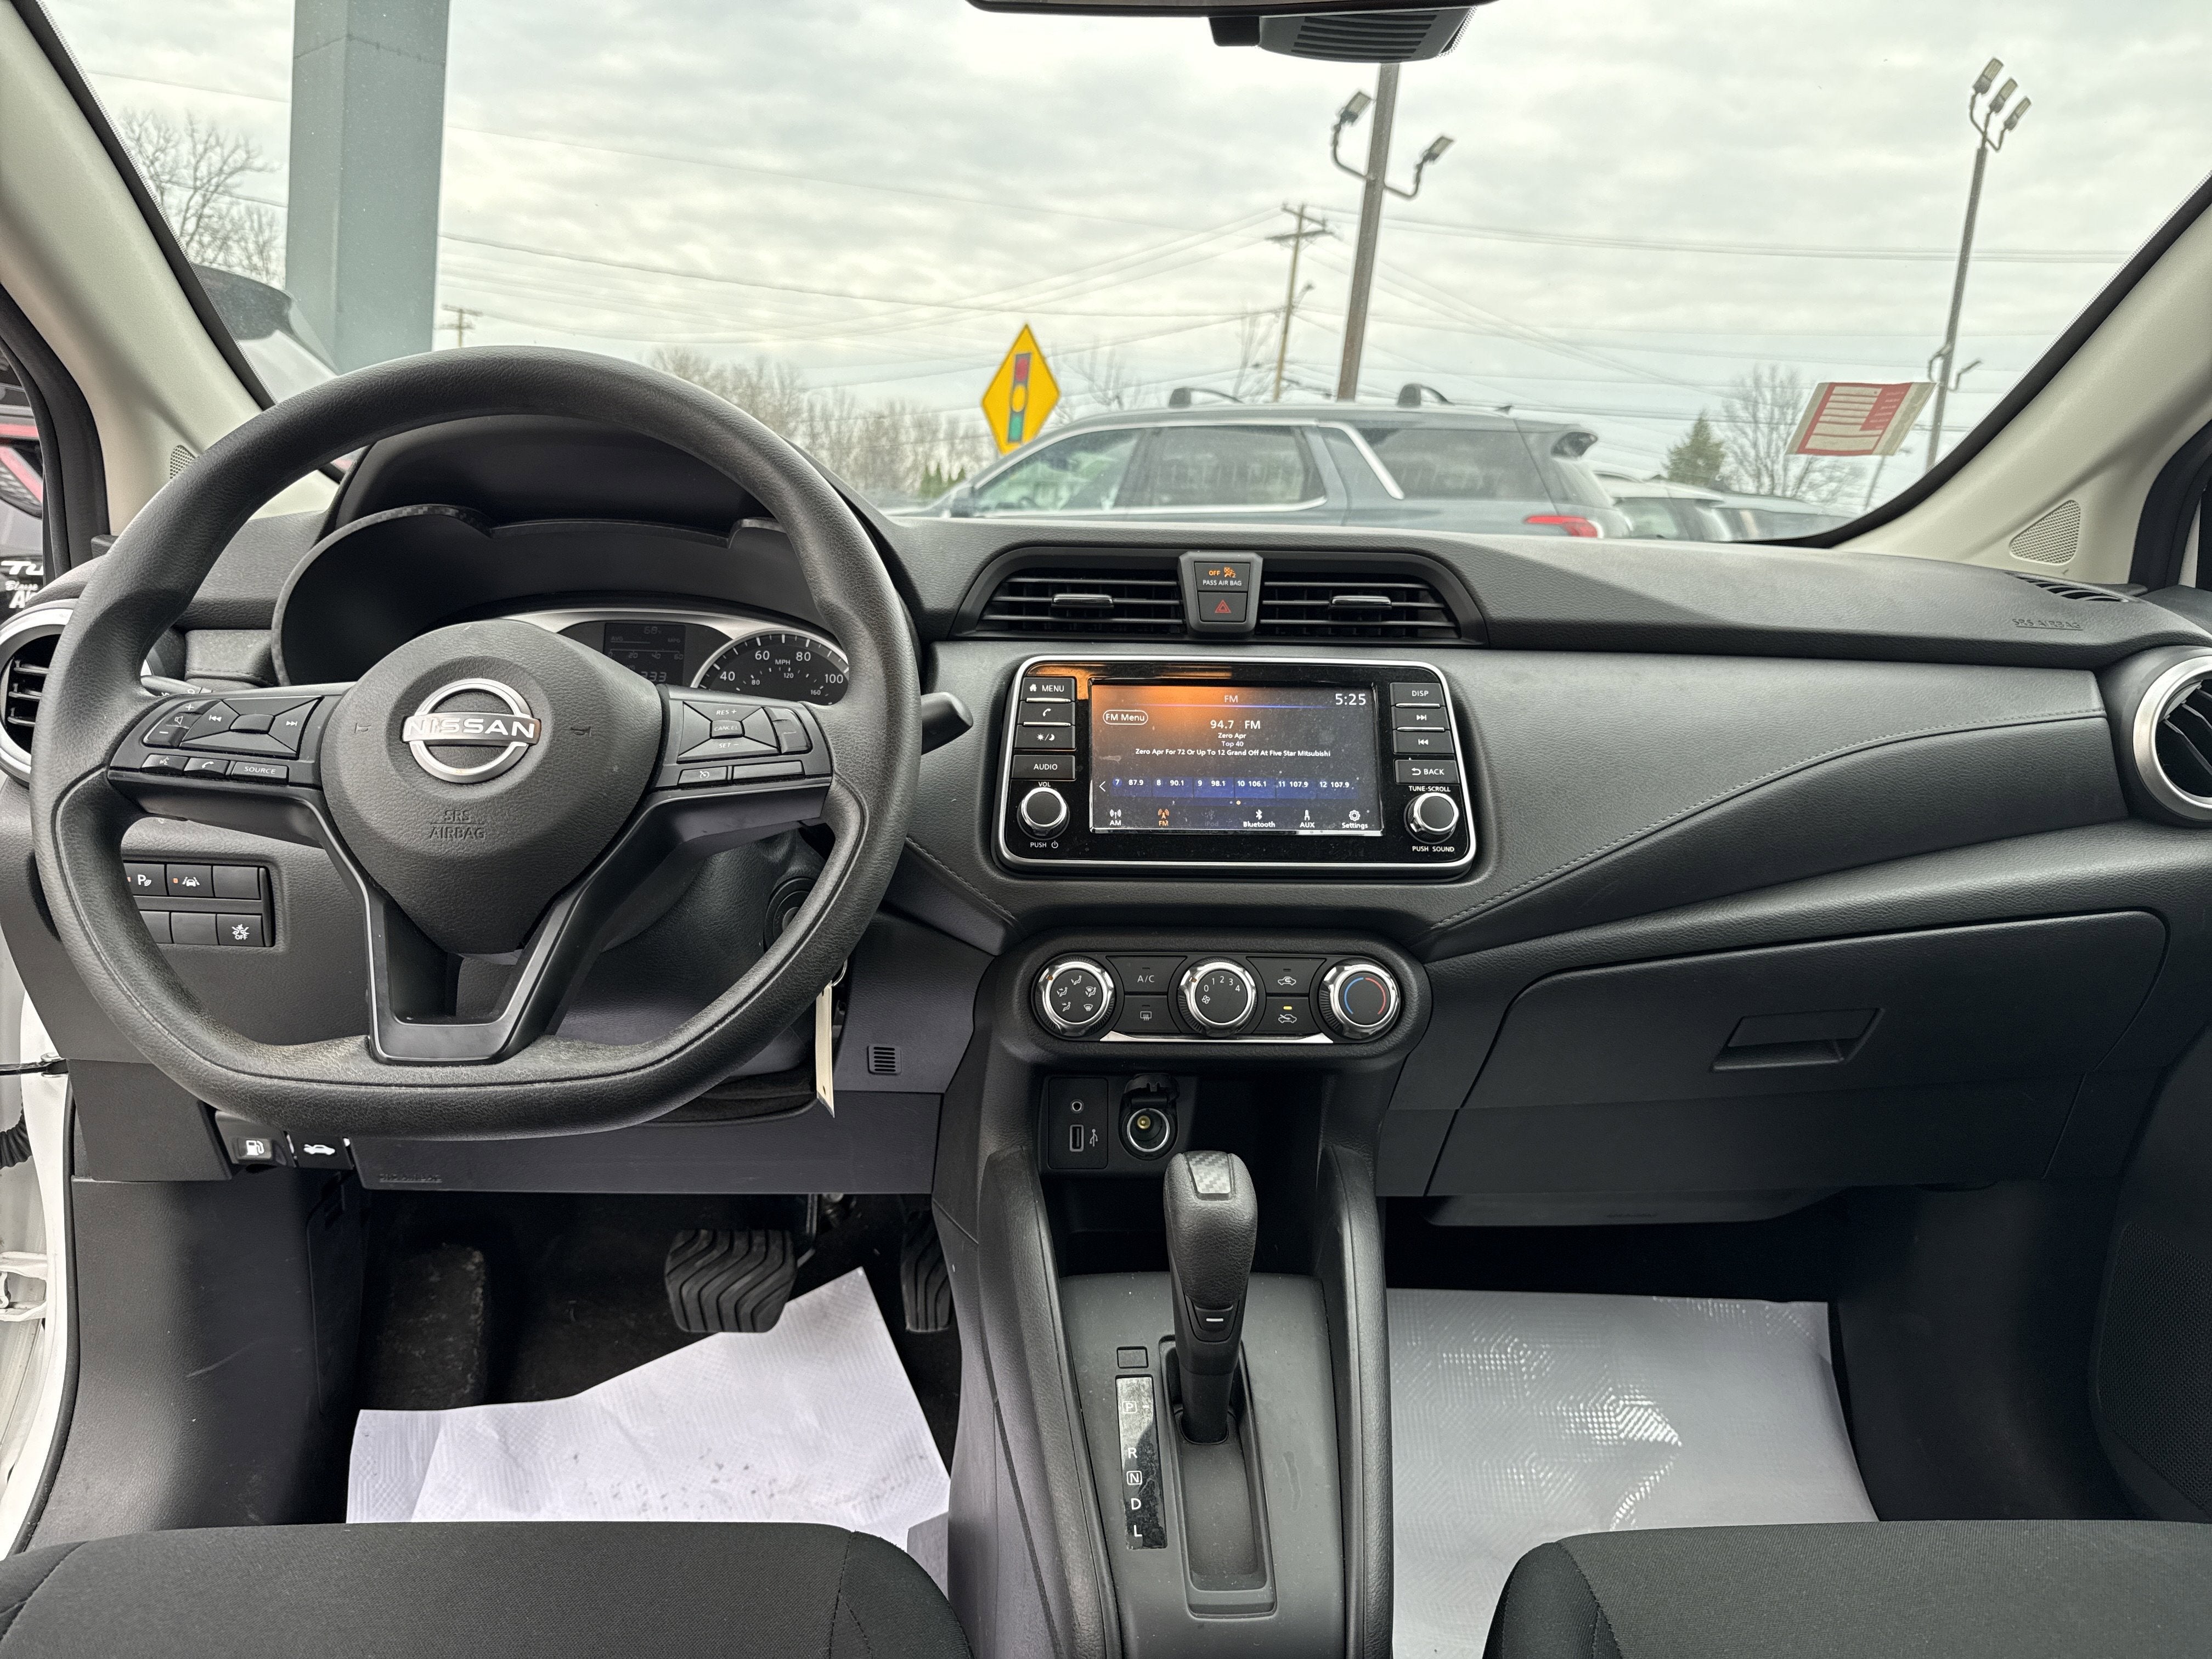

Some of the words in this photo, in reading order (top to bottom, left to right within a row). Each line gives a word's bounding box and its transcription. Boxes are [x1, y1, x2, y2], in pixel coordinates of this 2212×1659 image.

[2012, 618, 2034, 627] SRS
[2038, 619, 2081, 629] AIRBAG
[755, 650, 770, 661] 60
[795, 651, 811, 662] 80
[720, 671, 735, 681] 40
[825, 674, 844, 684] 100
[1335, 693, 1366, 706] 5:25
[406, 718, 535, 738] NISSAN
[1210, 720, 1234, 729] 94.7
[1244, 720, 1261, 730] FM
[244, 766, 276, 775] SOURCE
[443, 809, 471, 822] SRS
[430, 826, 486, 839] AIRBAG
[1137, 974, 1155, 983] A/C
[1204, 984, 1209, 992] 0
[1220, 975, 1224, 984] 2
[1235, 984, 1240, 992] 4
[1127, 1447, 1138, 1459] R
[1130, 1472, 1139, 1483] N
[1131, 1498, 1142, 1510] D
[1133, 1525, 1142, 1537] L
